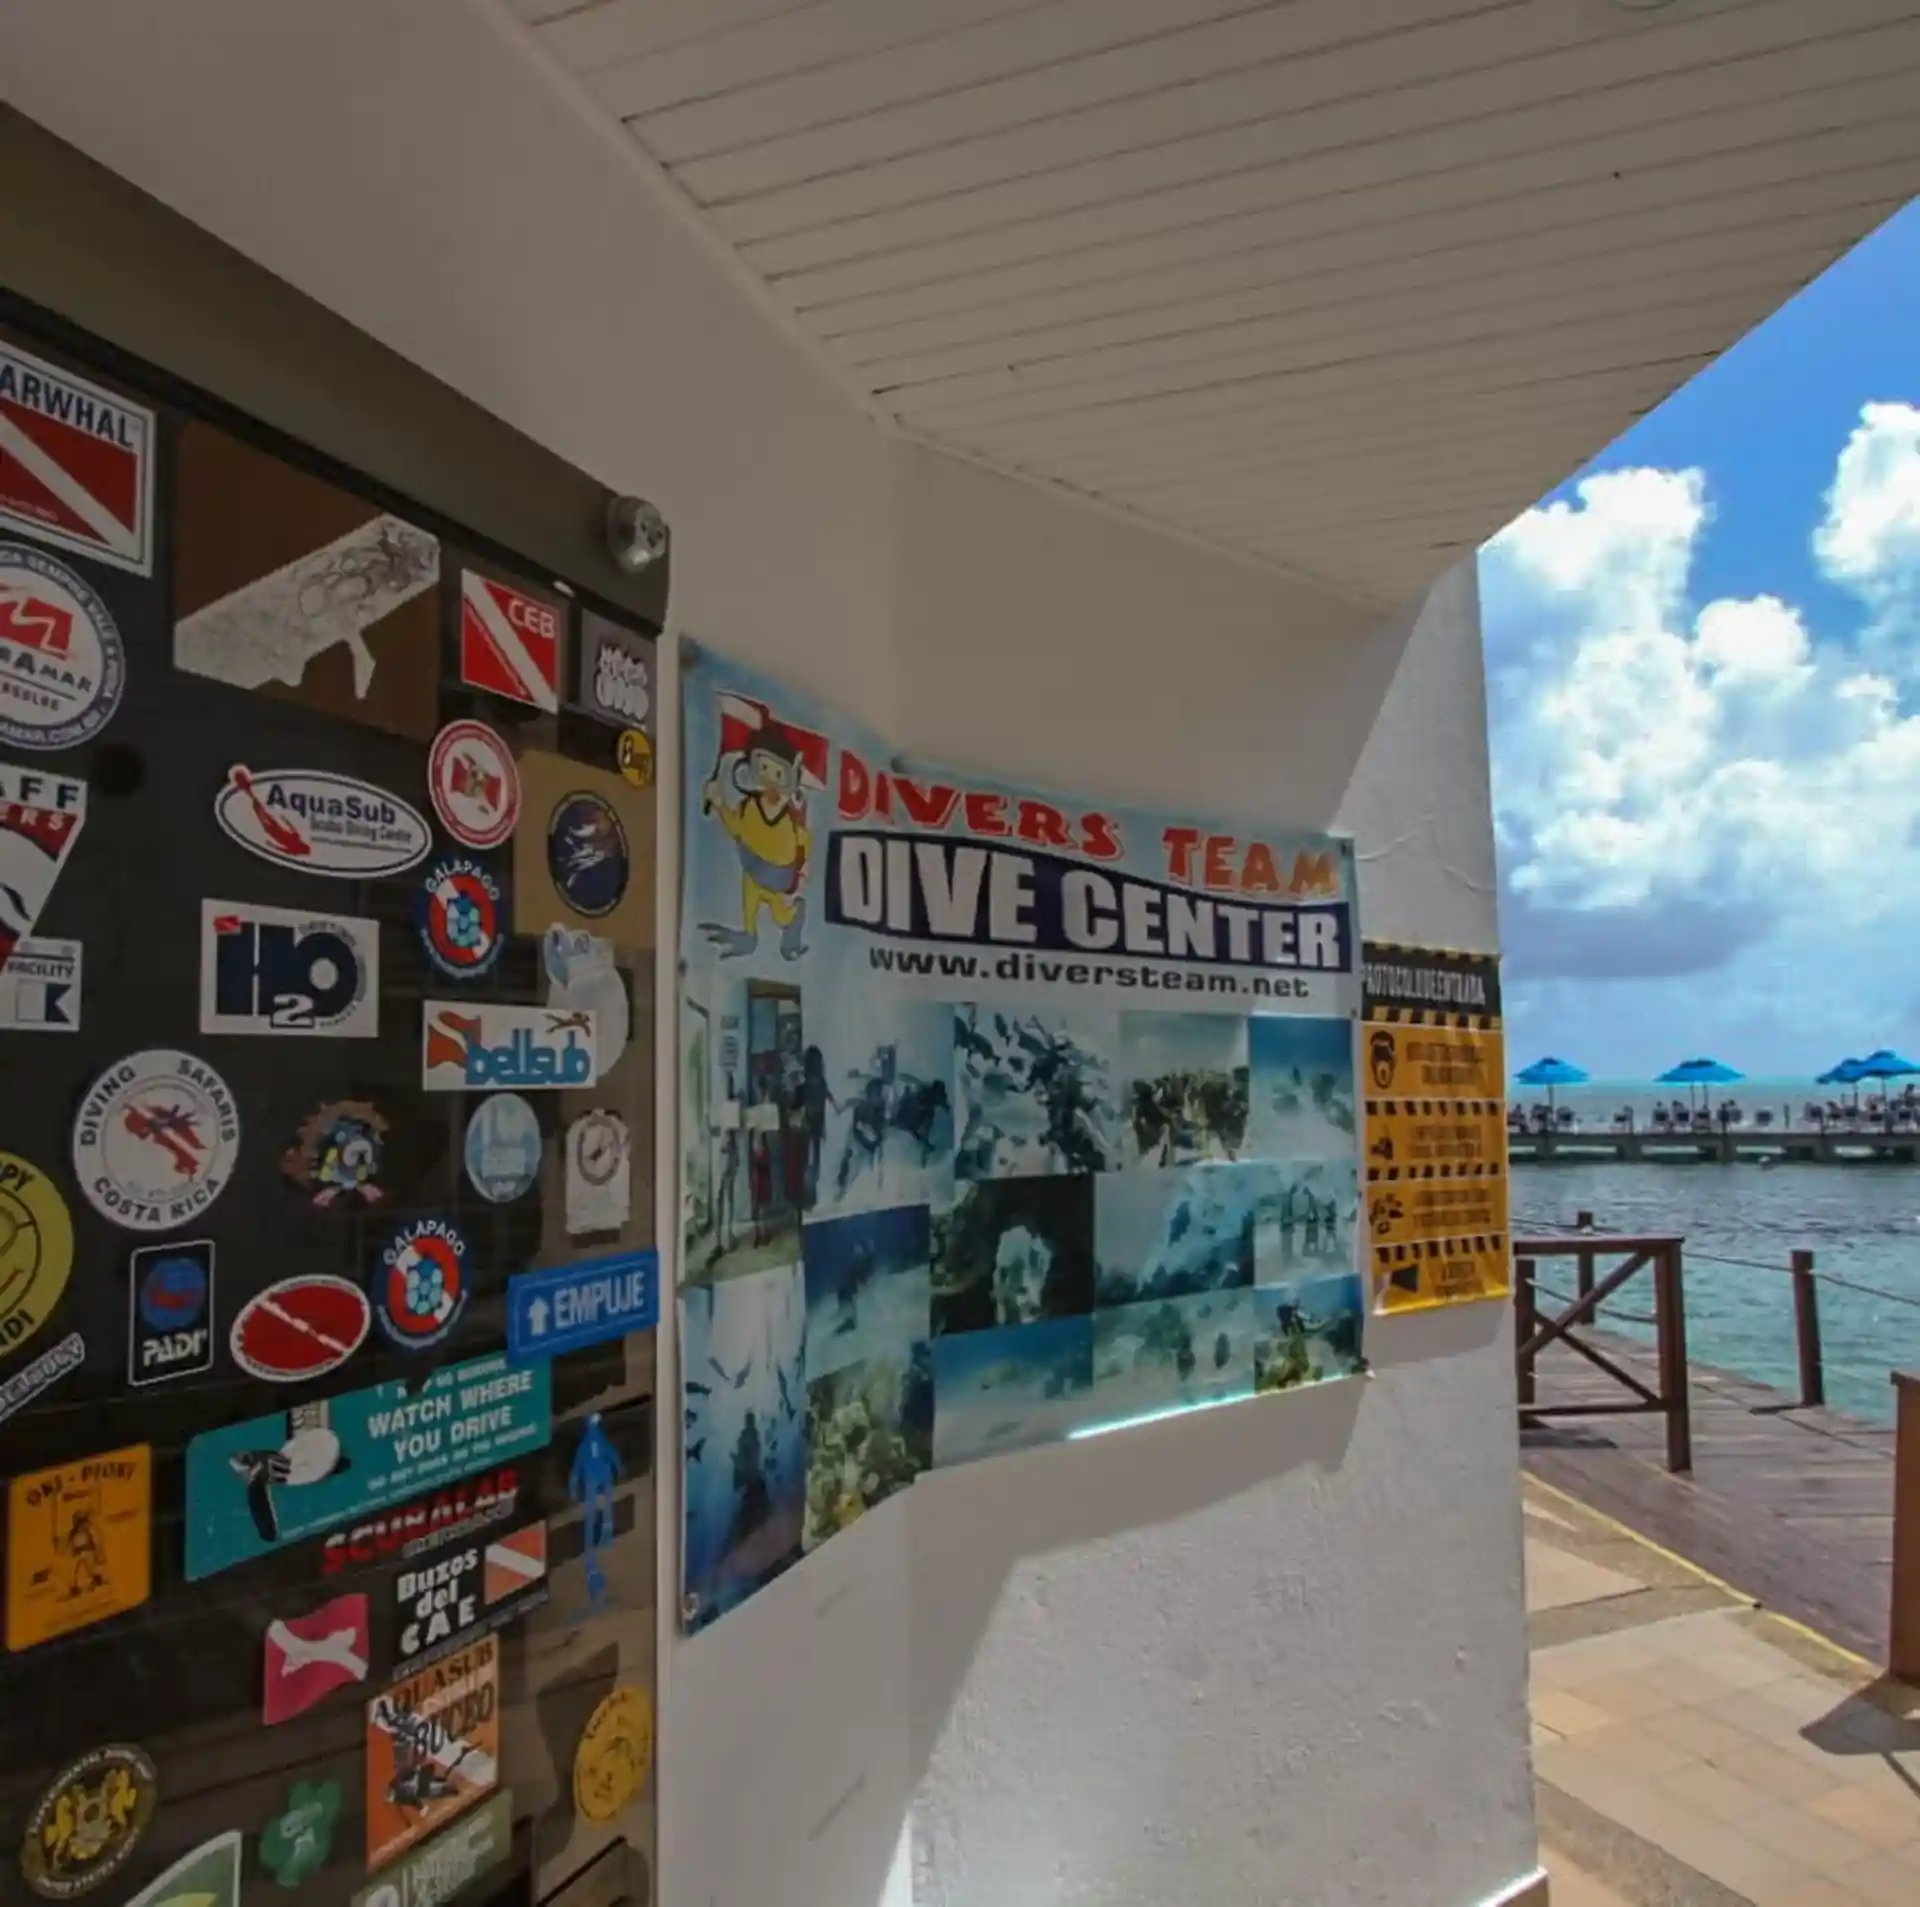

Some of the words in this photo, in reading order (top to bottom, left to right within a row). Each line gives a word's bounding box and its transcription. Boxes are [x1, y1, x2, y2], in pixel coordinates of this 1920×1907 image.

[507, 598, 556, 640] CEB
[0, 776, 80, 809] FF
[266, 784, 396, 825] AquaSub
[838, 749, 1125, 861] DIVERS
[1161, 827, 1339, 898] TEAM
[839, 836, 1036, 944] DIVE
[1061, 868, 1341, 968] CENTER
[869, 944, 1309, 999] www.diversteam.net
[80, 1063, 138, 1147] DIVING
[175, 1058, 237, 1144] SAFARIS
[92, 1175, 162, 1224] COSTA
[169, 1177, 221, 1221] RICA
[553, 1270, 645, 1330] EMPUJE
[142, 1330, 205, 1367] PADI
[367, 1394, 451, 1440] WATCH
[458, 1369, 534, 1413] WHERE
[393, 1425, 442, 1464] YOU
[450, 1404, 514, 1446] DRIVE
[415, 1579, 459, 1619] del
